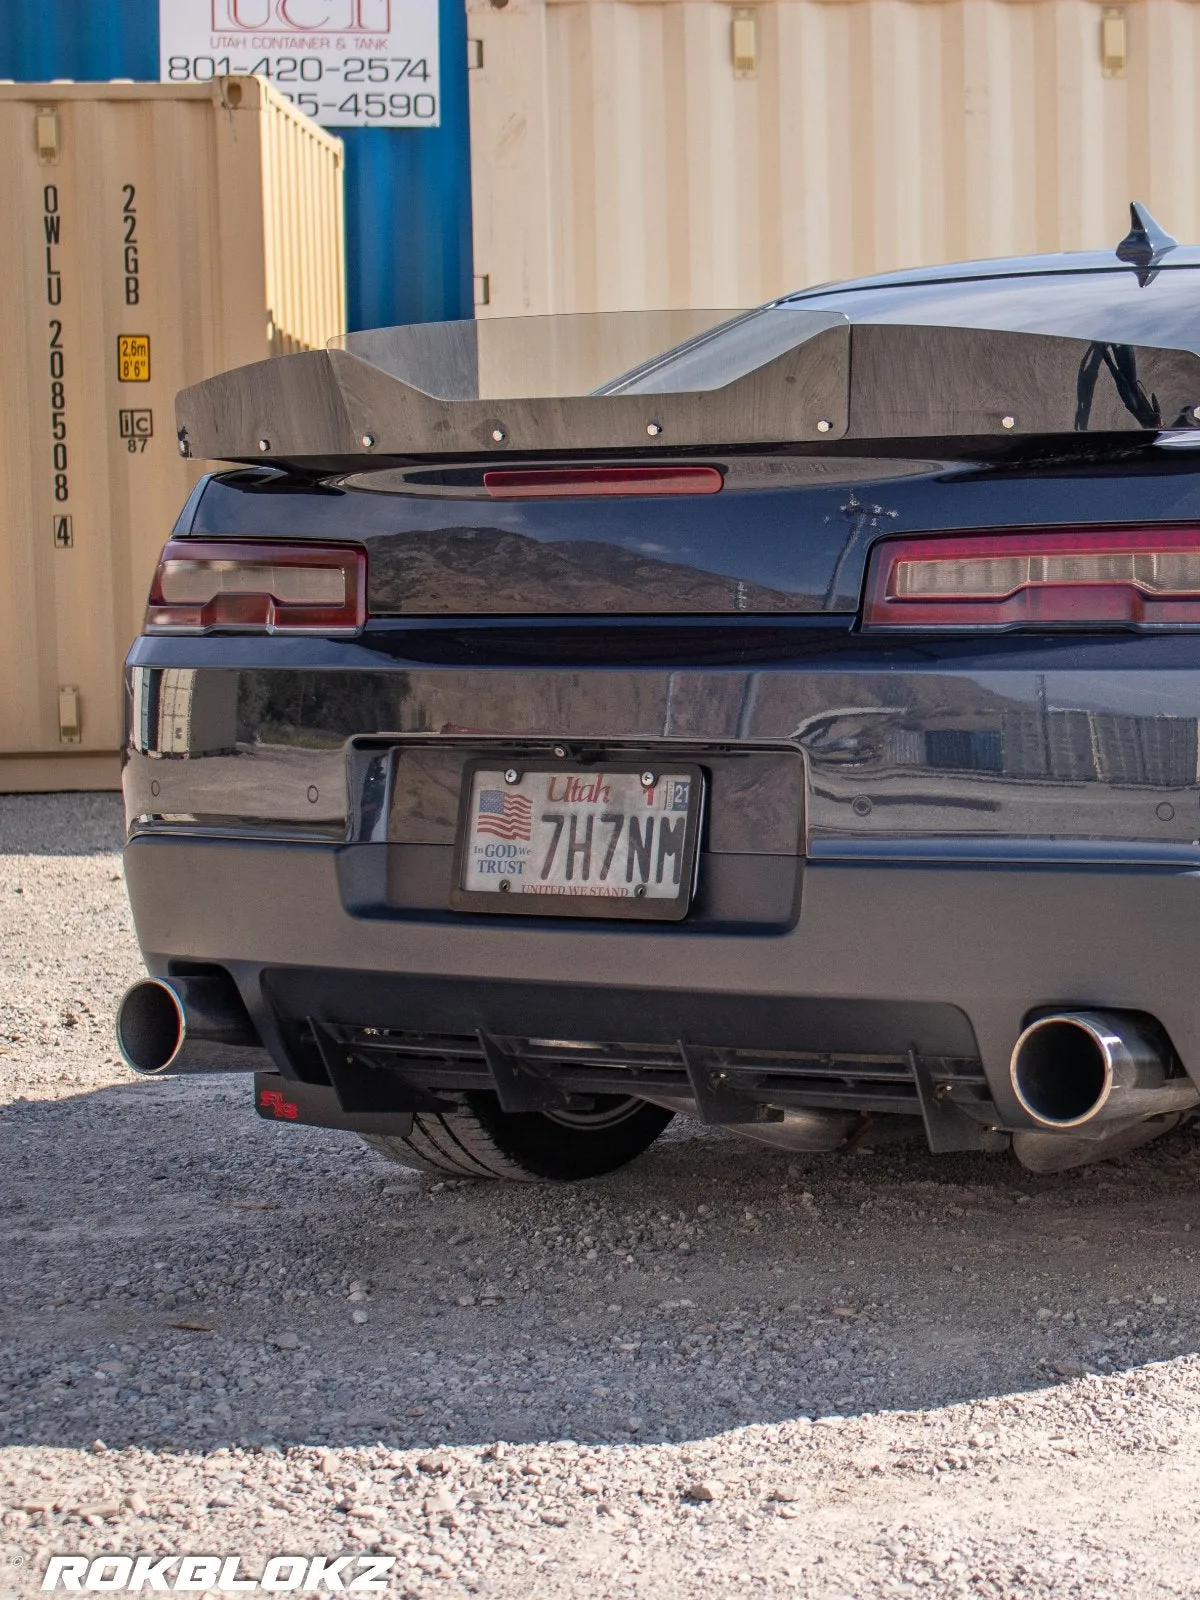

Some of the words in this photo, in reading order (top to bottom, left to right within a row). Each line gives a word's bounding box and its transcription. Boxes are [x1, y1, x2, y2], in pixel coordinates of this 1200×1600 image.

[209, 37, 247, 49] UTAH
[251, 37, 331, 50] CONTAINER
[335, 38, 347, 50] &
[353, 38, 389, 50] TANK
[168, 56, 431, 83] 801-420-2574
[43, 184, 62, 306] OWLU
[122, 184, 140, 306] 22GB
[49, 319, 69, 502] 208508
[127, 439, 148, 453] 87
[56, 517, 71, 547] 4
[548, 773, 612, 804] Utah
[674, 784, 689, 803] 21
[473, 845, 484, 854] In
[484, 844, 518, 858] GOD
[519, 847, 532, 856] We
[540, 813, 686, 885] 7H7NM
[477, 860, 527, 874] TRUST
[521, 884, 567, 895] UNITED
[568, 886, 588, 896] WE
[589, 886, 630, 897] STAND
